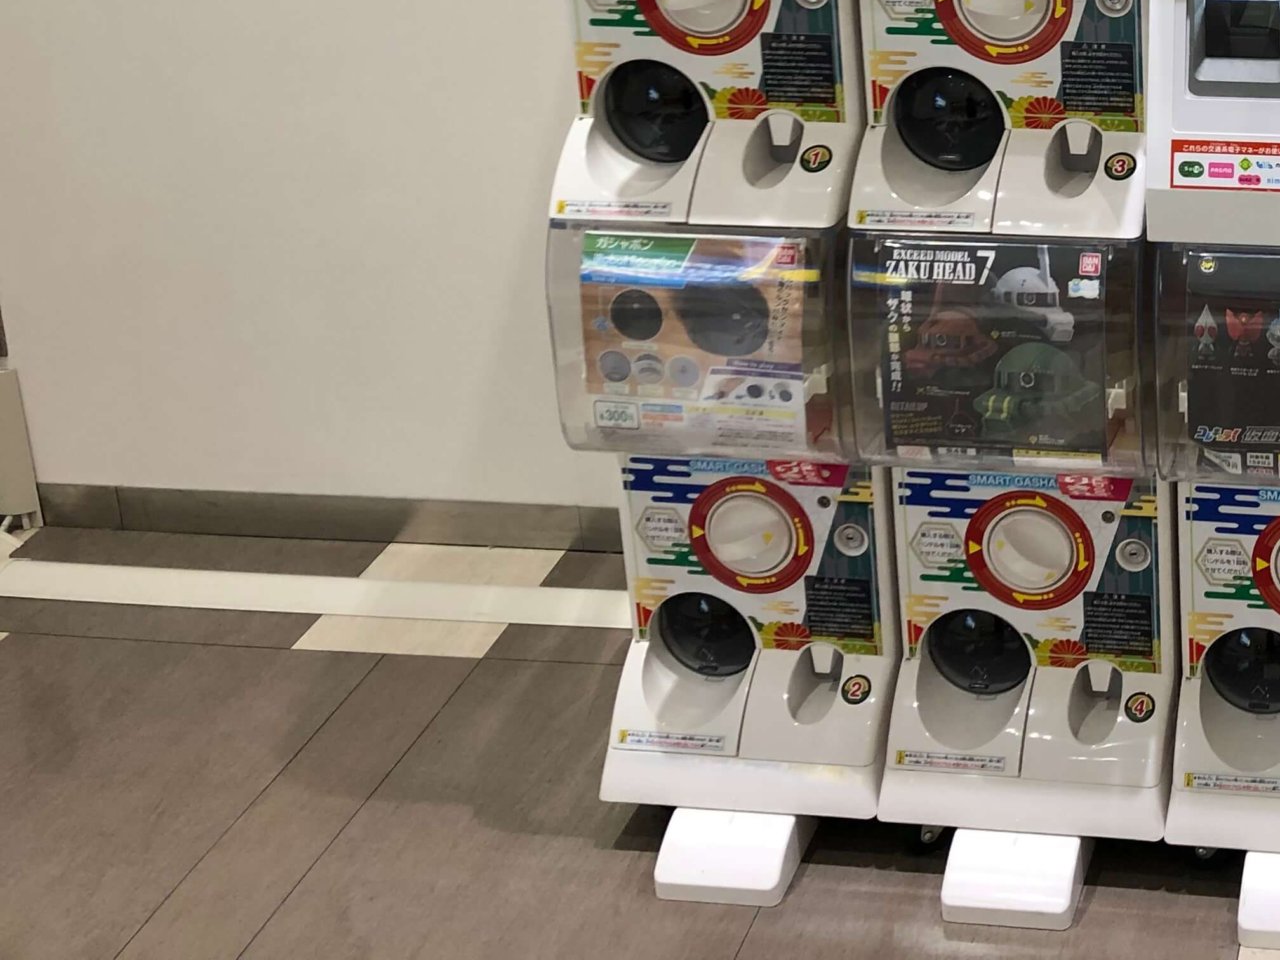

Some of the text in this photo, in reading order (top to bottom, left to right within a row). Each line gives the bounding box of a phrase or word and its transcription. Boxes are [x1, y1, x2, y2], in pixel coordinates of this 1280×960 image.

[809, 149, 821, 167] 1
[1113, 158, 1126, 174] 3
[892, 249, 971, 262] EXCEED MODEL
[885, 260, 976, 281] ZAKU HEAD
[976, 249, 996, 286] 7
[850, 682, 862, 698] 2
[1133, 699, 1146, 717] 4
